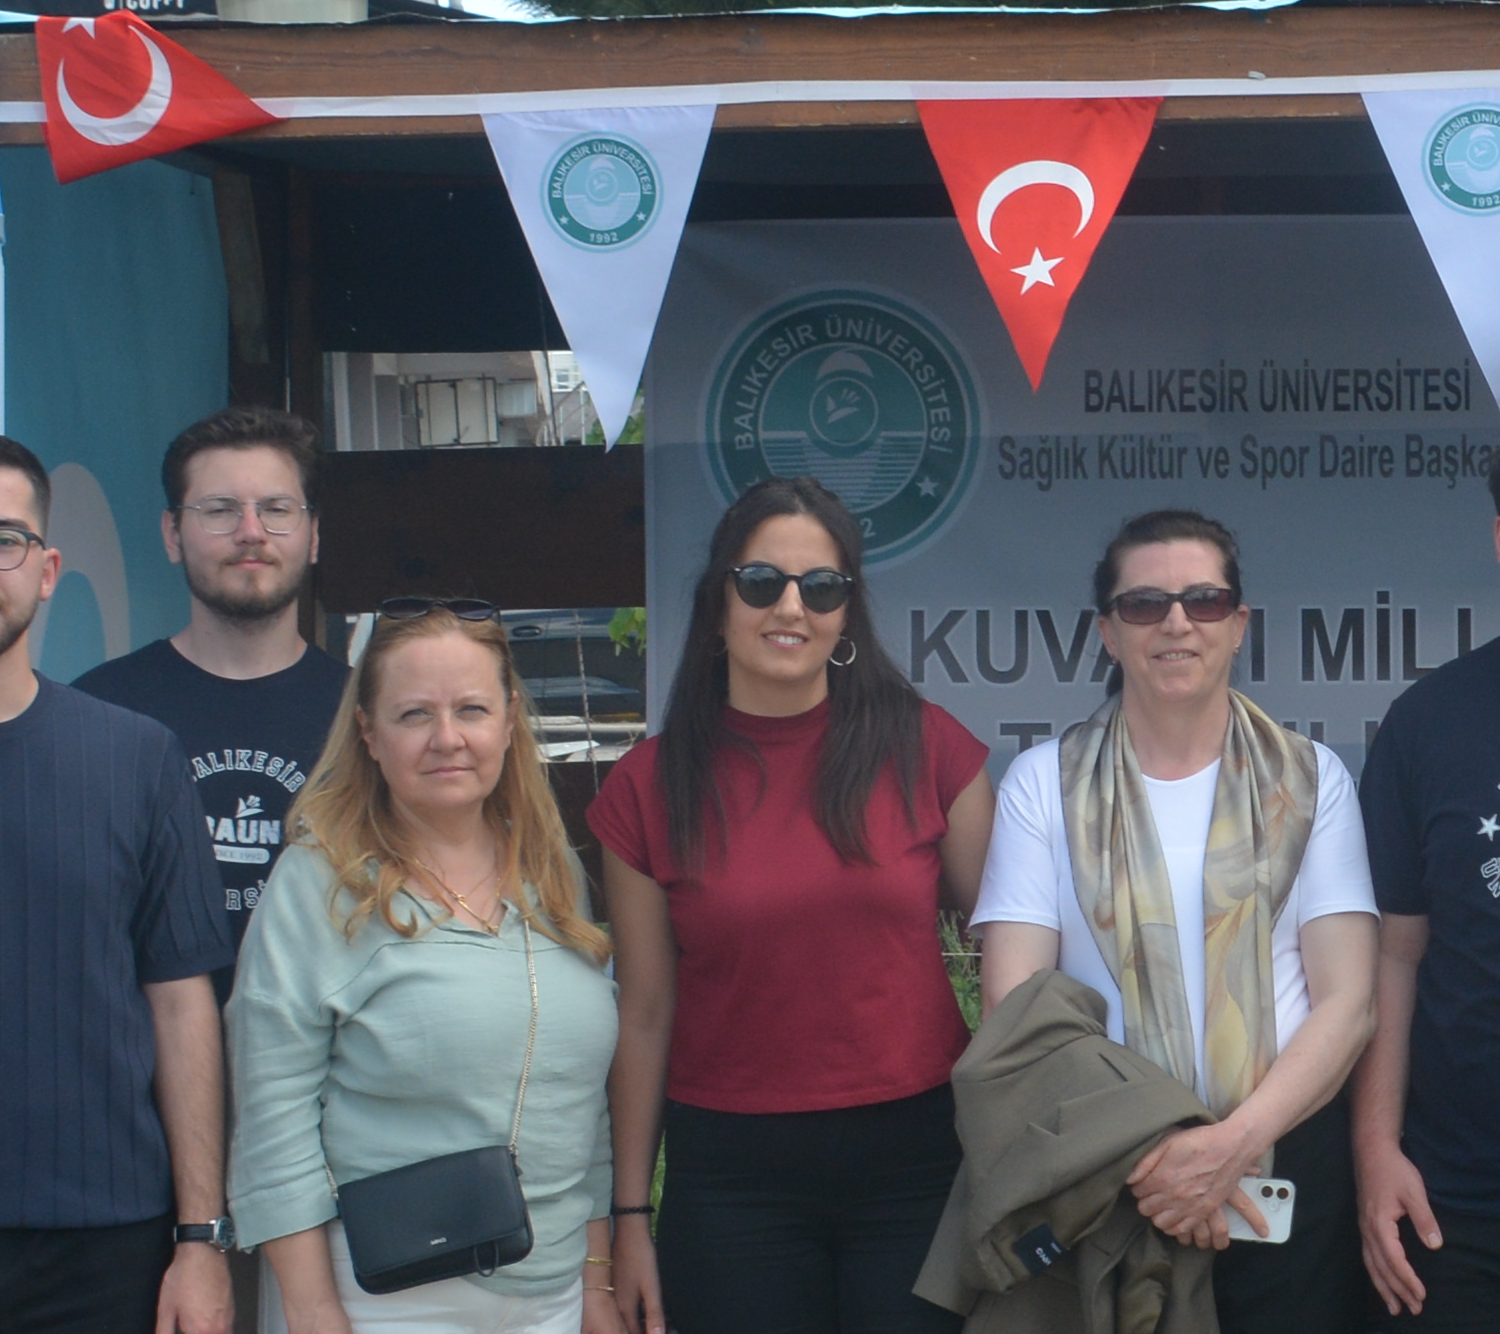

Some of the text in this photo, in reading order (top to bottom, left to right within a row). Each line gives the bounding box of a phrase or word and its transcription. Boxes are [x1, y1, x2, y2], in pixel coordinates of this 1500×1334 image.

[589, 231, 619, 244] 1992
[733, 314, 954, 454] BALIKESİR ÜNİVERSİTESİ
[1083, 358, 1472, 414] BALIKESİR ÜNİVERSİTESİ
[999, 433, 1495, 492] Sağlık Kültür ve Spor Daire Başka
[191, 749, 306, 793] ALIKESİR
